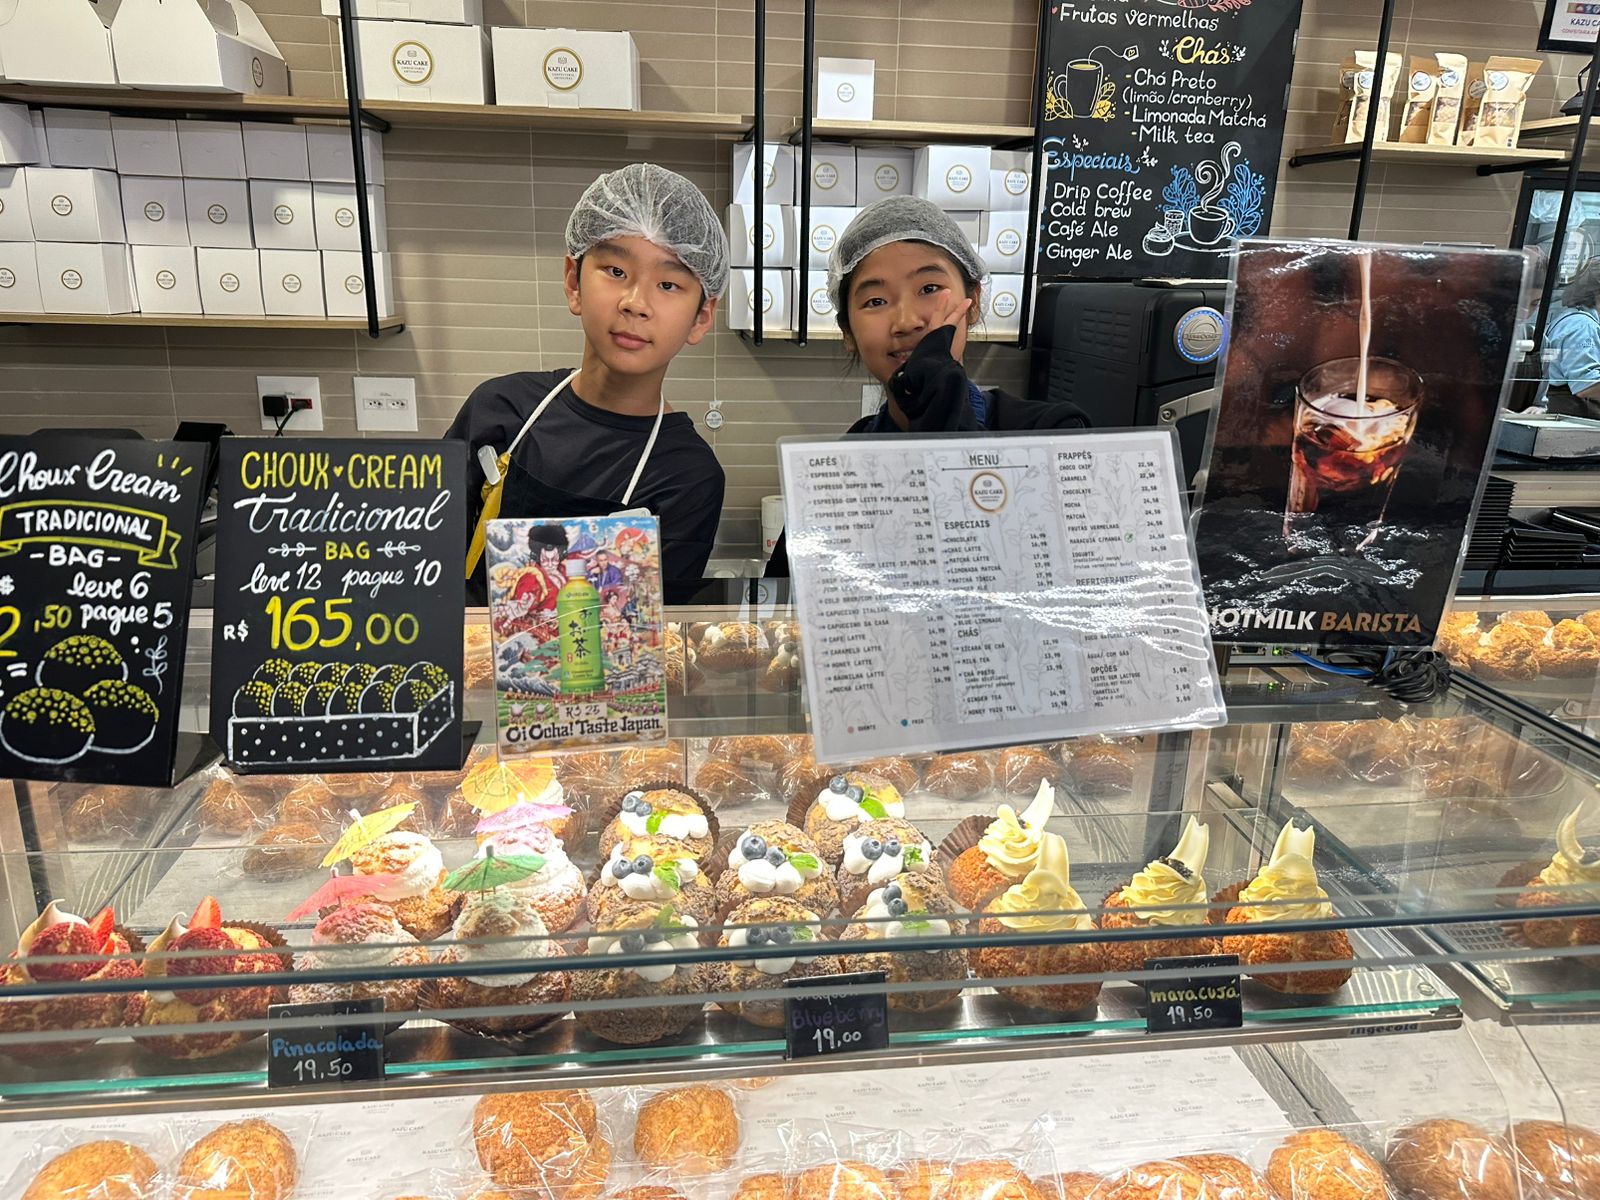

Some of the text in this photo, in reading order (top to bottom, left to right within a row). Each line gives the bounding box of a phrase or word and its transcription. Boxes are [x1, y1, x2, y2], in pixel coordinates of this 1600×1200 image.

[1060, 3, 1117, 25] Frutas
[1173, 36, 1231, 65] Chás
[1172, 71, 1217, 90] Preto
[1208, 111, 1267, 129] Matchá
[1184, 127, 1215, 144] tea
[1043, 136, 1141, 182] Especiais
[1053, 182, 1153, 207] Drip Coffee
[1050, 202, 1132, 218] Cold brew
[1047, 221, 1119, 241] Café Ale
[1046, 243, 1133, 268] Ginger Ale
[809, 458, 837, 468] CAFÉS
[969, 455, 999, 466] MENU
[1058, 451, 1092, 461] FRAPPÉS
[0, 448, 182, 503] Choux Cream
[241, 451, 443, 490] CHOUX CREAM
[233, 490, 451, 534] Tradicional
[16, 509, 153, 541] TRADICIONAL
[944, 520, 990, 530] ESPECIAIS
[1090, 523, 1120, 531] VERMELHAS
[325, 541, 370, 561] BAG
[66, 571, 152, 600] leve 6
[240, 558, 441, 599] leve 12 pague 10
[80, 601, 174, 636] pague 5
[265, 595, 420, 651] 165,00
[1320, 611, 1421, 633] BARISTA
[223, 620, 249, 642] R$
[958, 628, 979, 637] CHÁS
[830, 648, 860, 656] CARAMELO
[1091, 665, 1117, 675] OPÇÕES
[506, 716, 663, 742] Oi Ocha! Taste Japan.
[792, 1005, 885, 1029] Blueberry
[1167, 1005, 1212, 1025] 19,50
[812, 1028, 862, 1053] 19,00
[293, 1058, 353, 1081] 19,50
